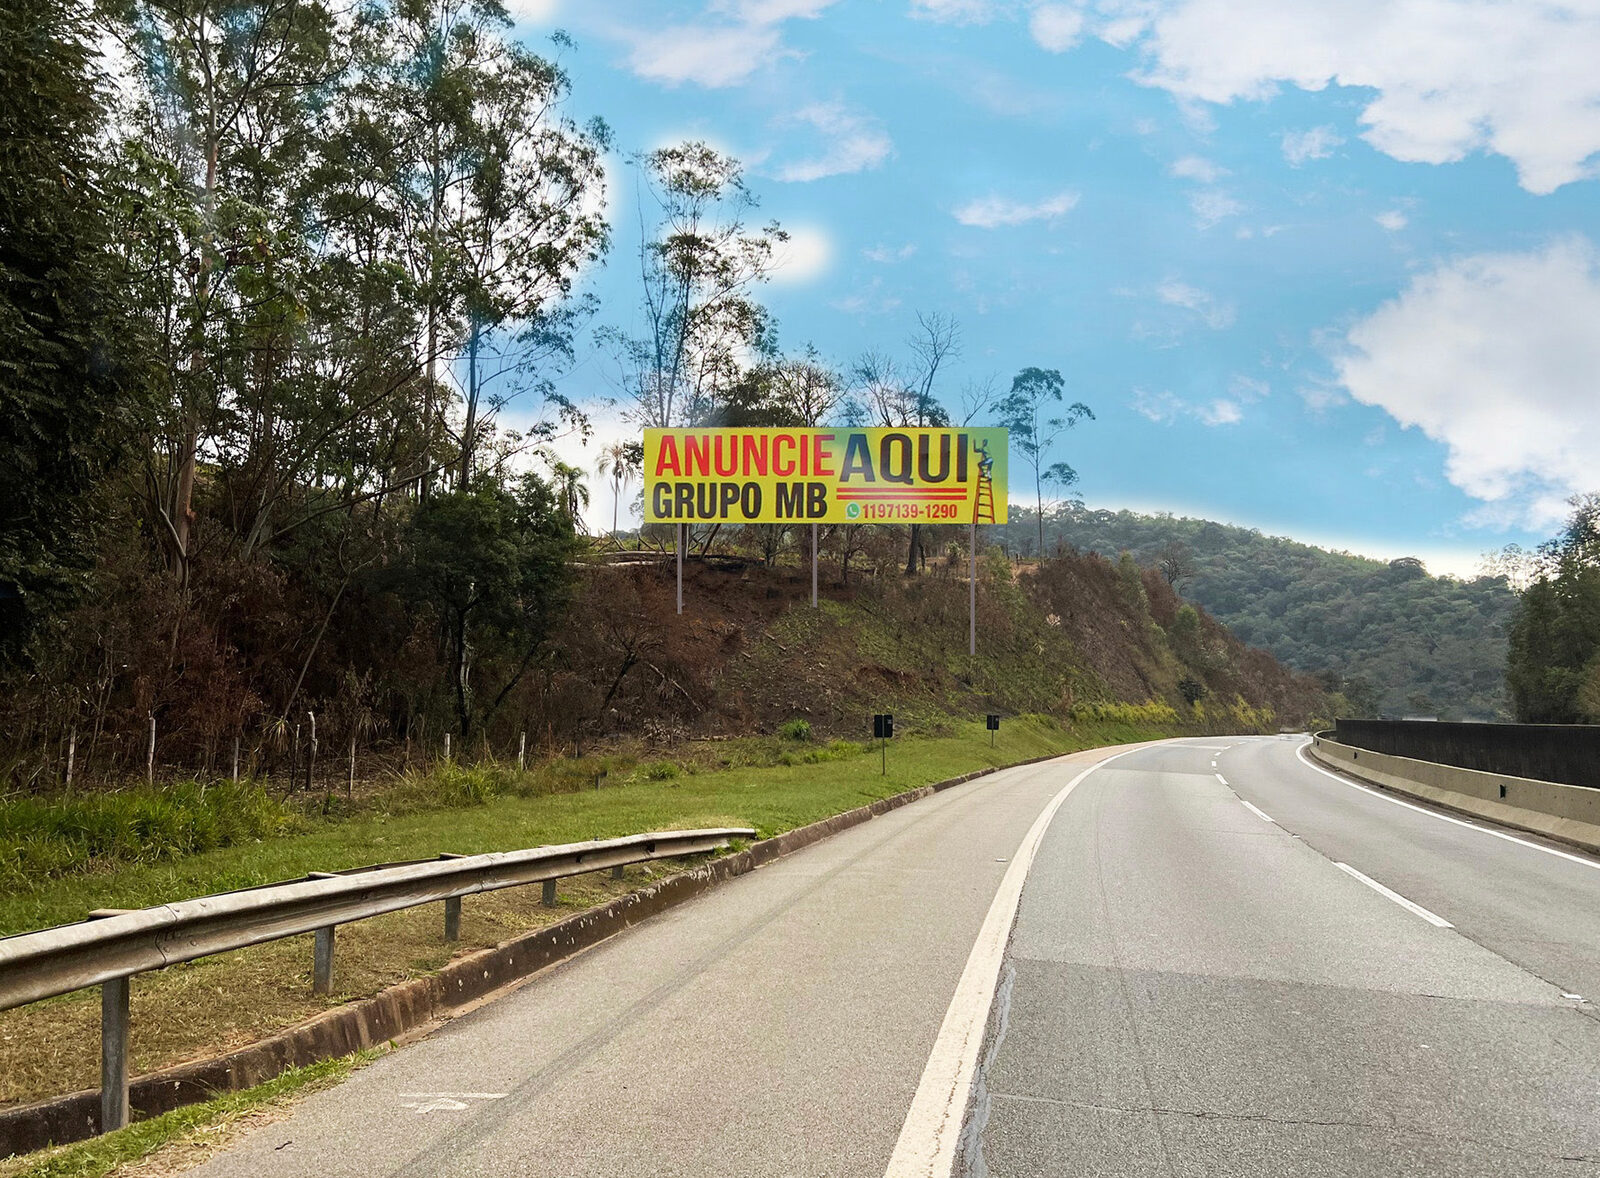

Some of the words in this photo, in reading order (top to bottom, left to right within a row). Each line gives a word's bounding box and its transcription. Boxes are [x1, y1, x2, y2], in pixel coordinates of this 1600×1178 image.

[655, 434, 835, 477] ANUNCIE
[839, 433, 968, 485] AQUI
[652, 482, 762, 519] GRUPO
[776, 482, 827, 519] MB
[862, 503, 958, 519] 1197139-1290
